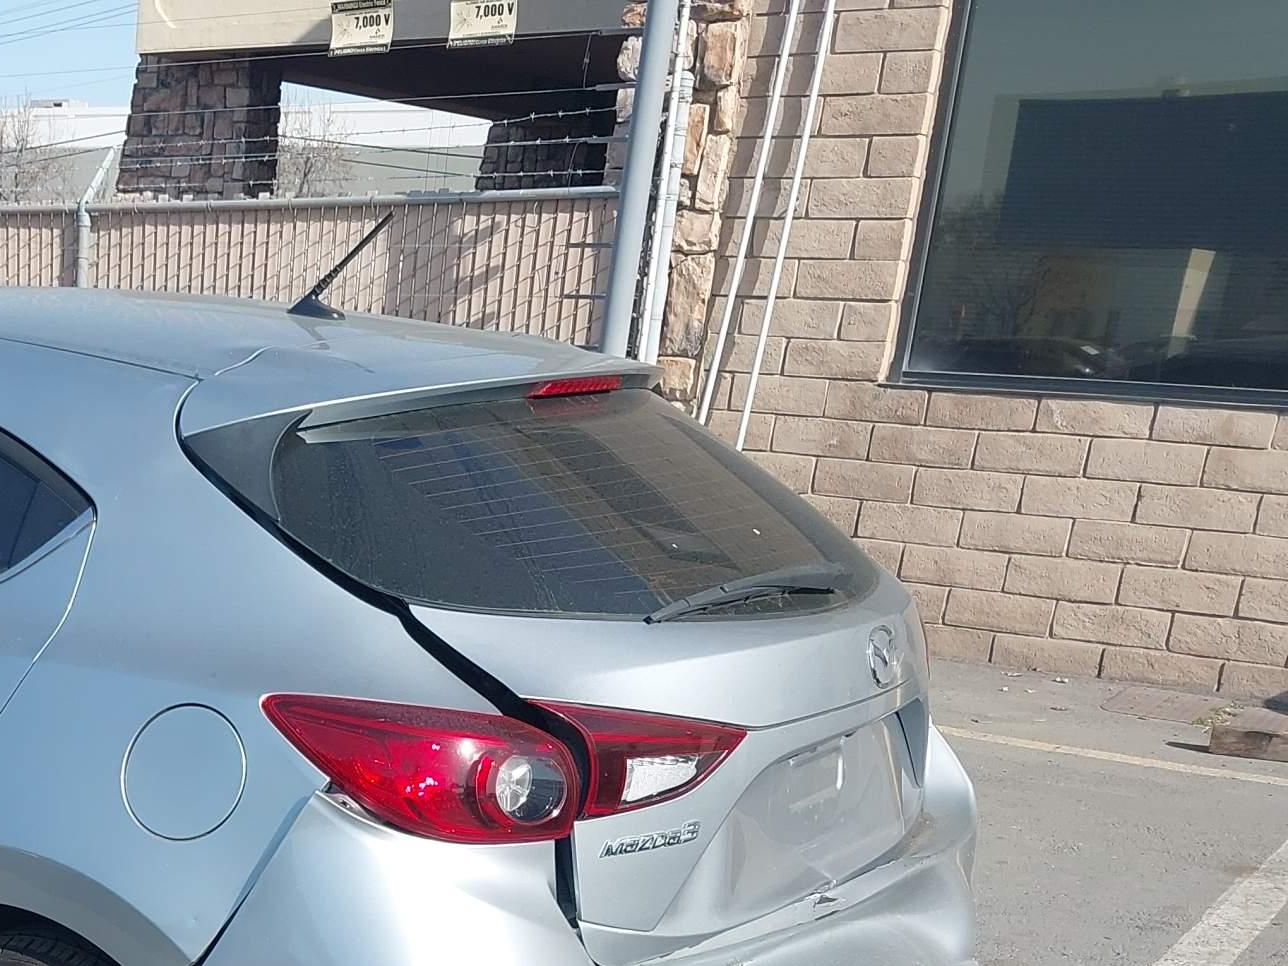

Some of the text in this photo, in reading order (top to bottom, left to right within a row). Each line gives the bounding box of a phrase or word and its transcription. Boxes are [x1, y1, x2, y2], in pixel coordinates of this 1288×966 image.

[475, 2, 514, 20] 7,000 V
[354, 14, 381, 30] 7,000
[384, 13, 390, 26] V
